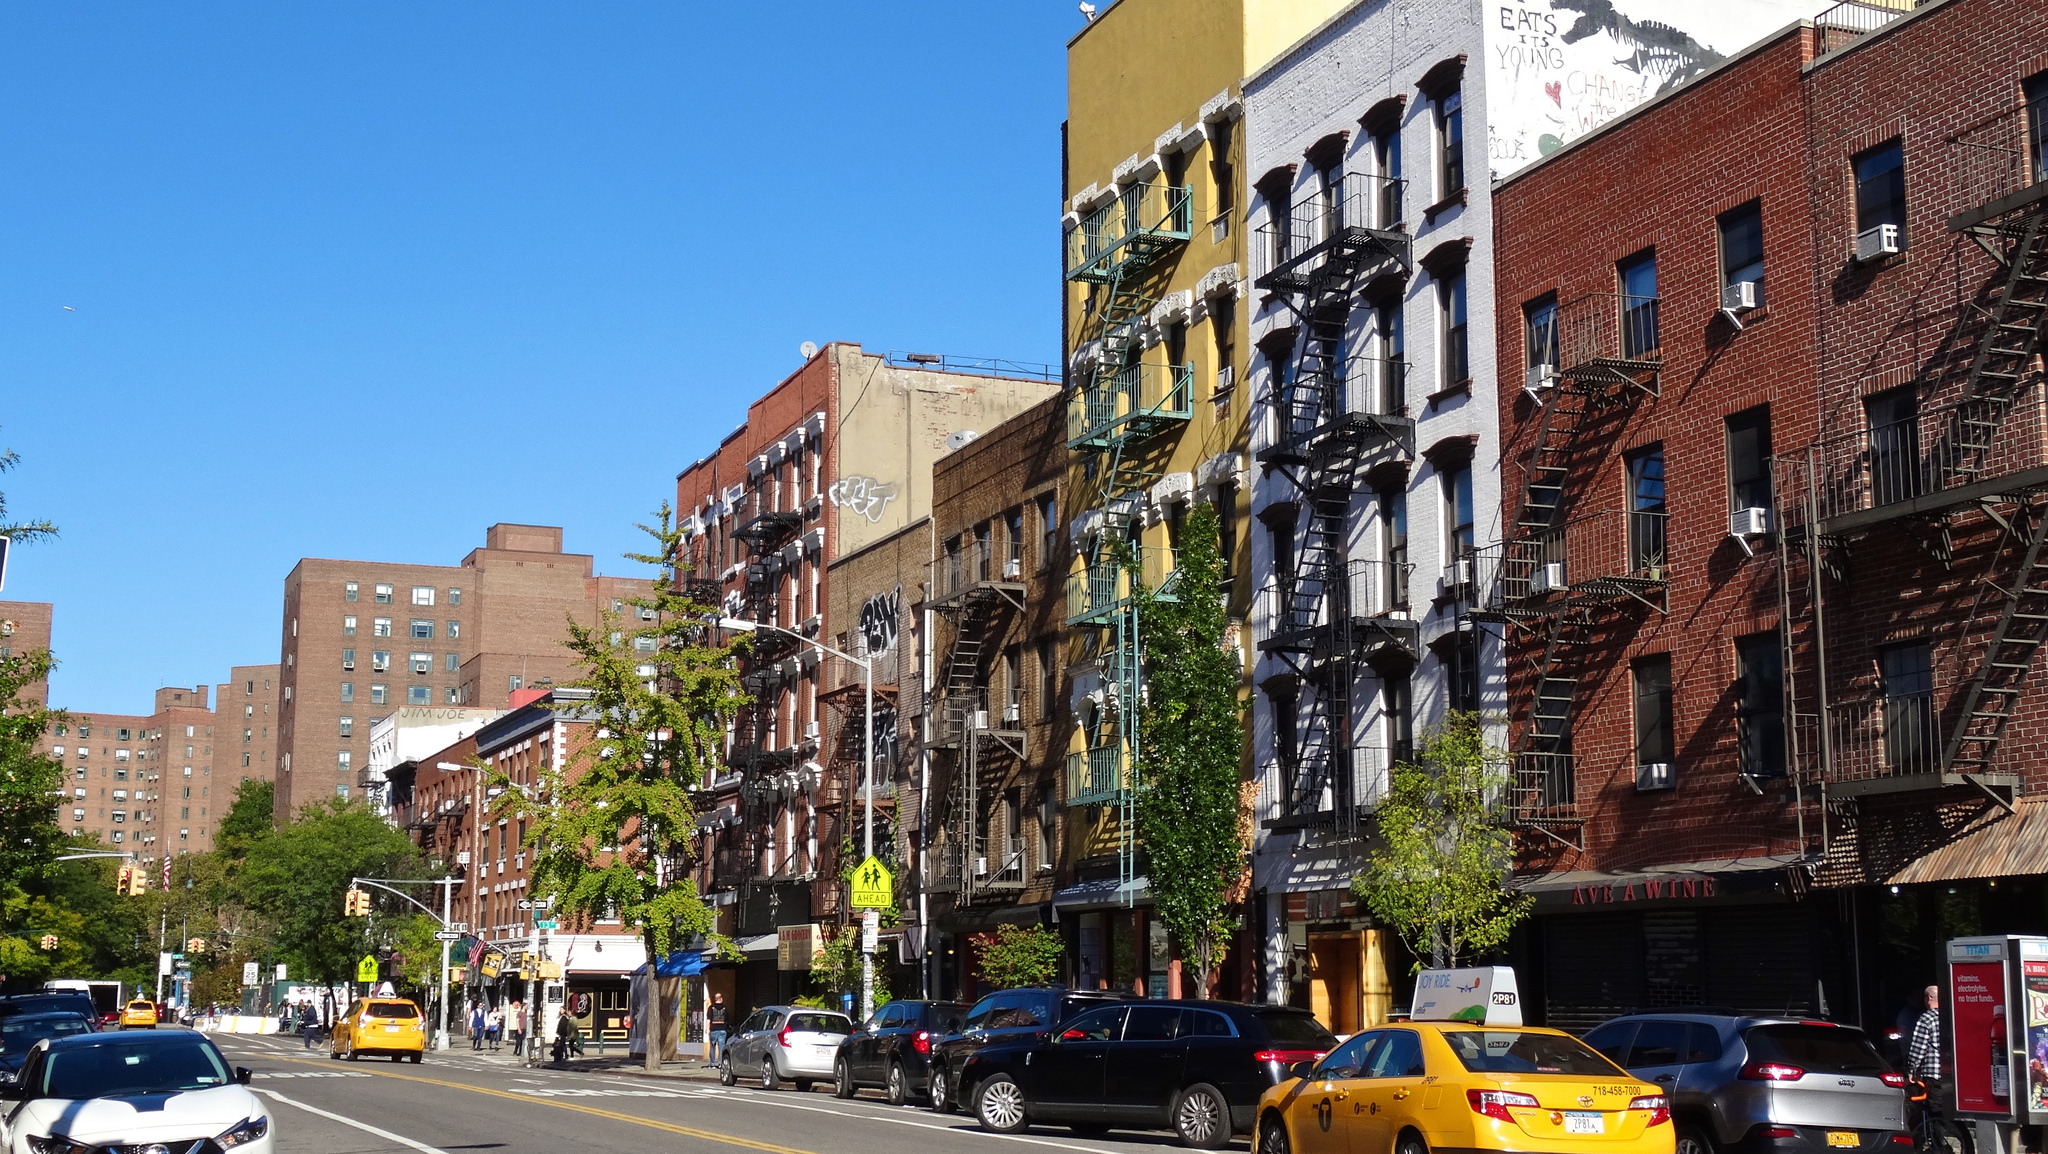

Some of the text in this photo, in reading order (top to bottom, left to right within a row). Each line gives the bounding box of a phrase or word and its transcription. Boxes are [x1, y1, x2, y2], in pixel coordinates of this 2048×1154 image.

[1500, 7, 1557, 36] EATS
[1496, 44, 1564, 70] YOUNG
[402, 708, 467, 719] JIM JOE
[1572, 877, 1716, 905] AVE A WINE
[857, 895, 887, 903] AHEAD
[1965, 945, 1990, 955] TITAN
[245, 971, 256, 979] 25
[1419, 973, 1451, 989] JOY RIDE
[1492, 993, 1514, 1005] 2P81
[1593, 1086, 1641, 1096] 718-458-7000
